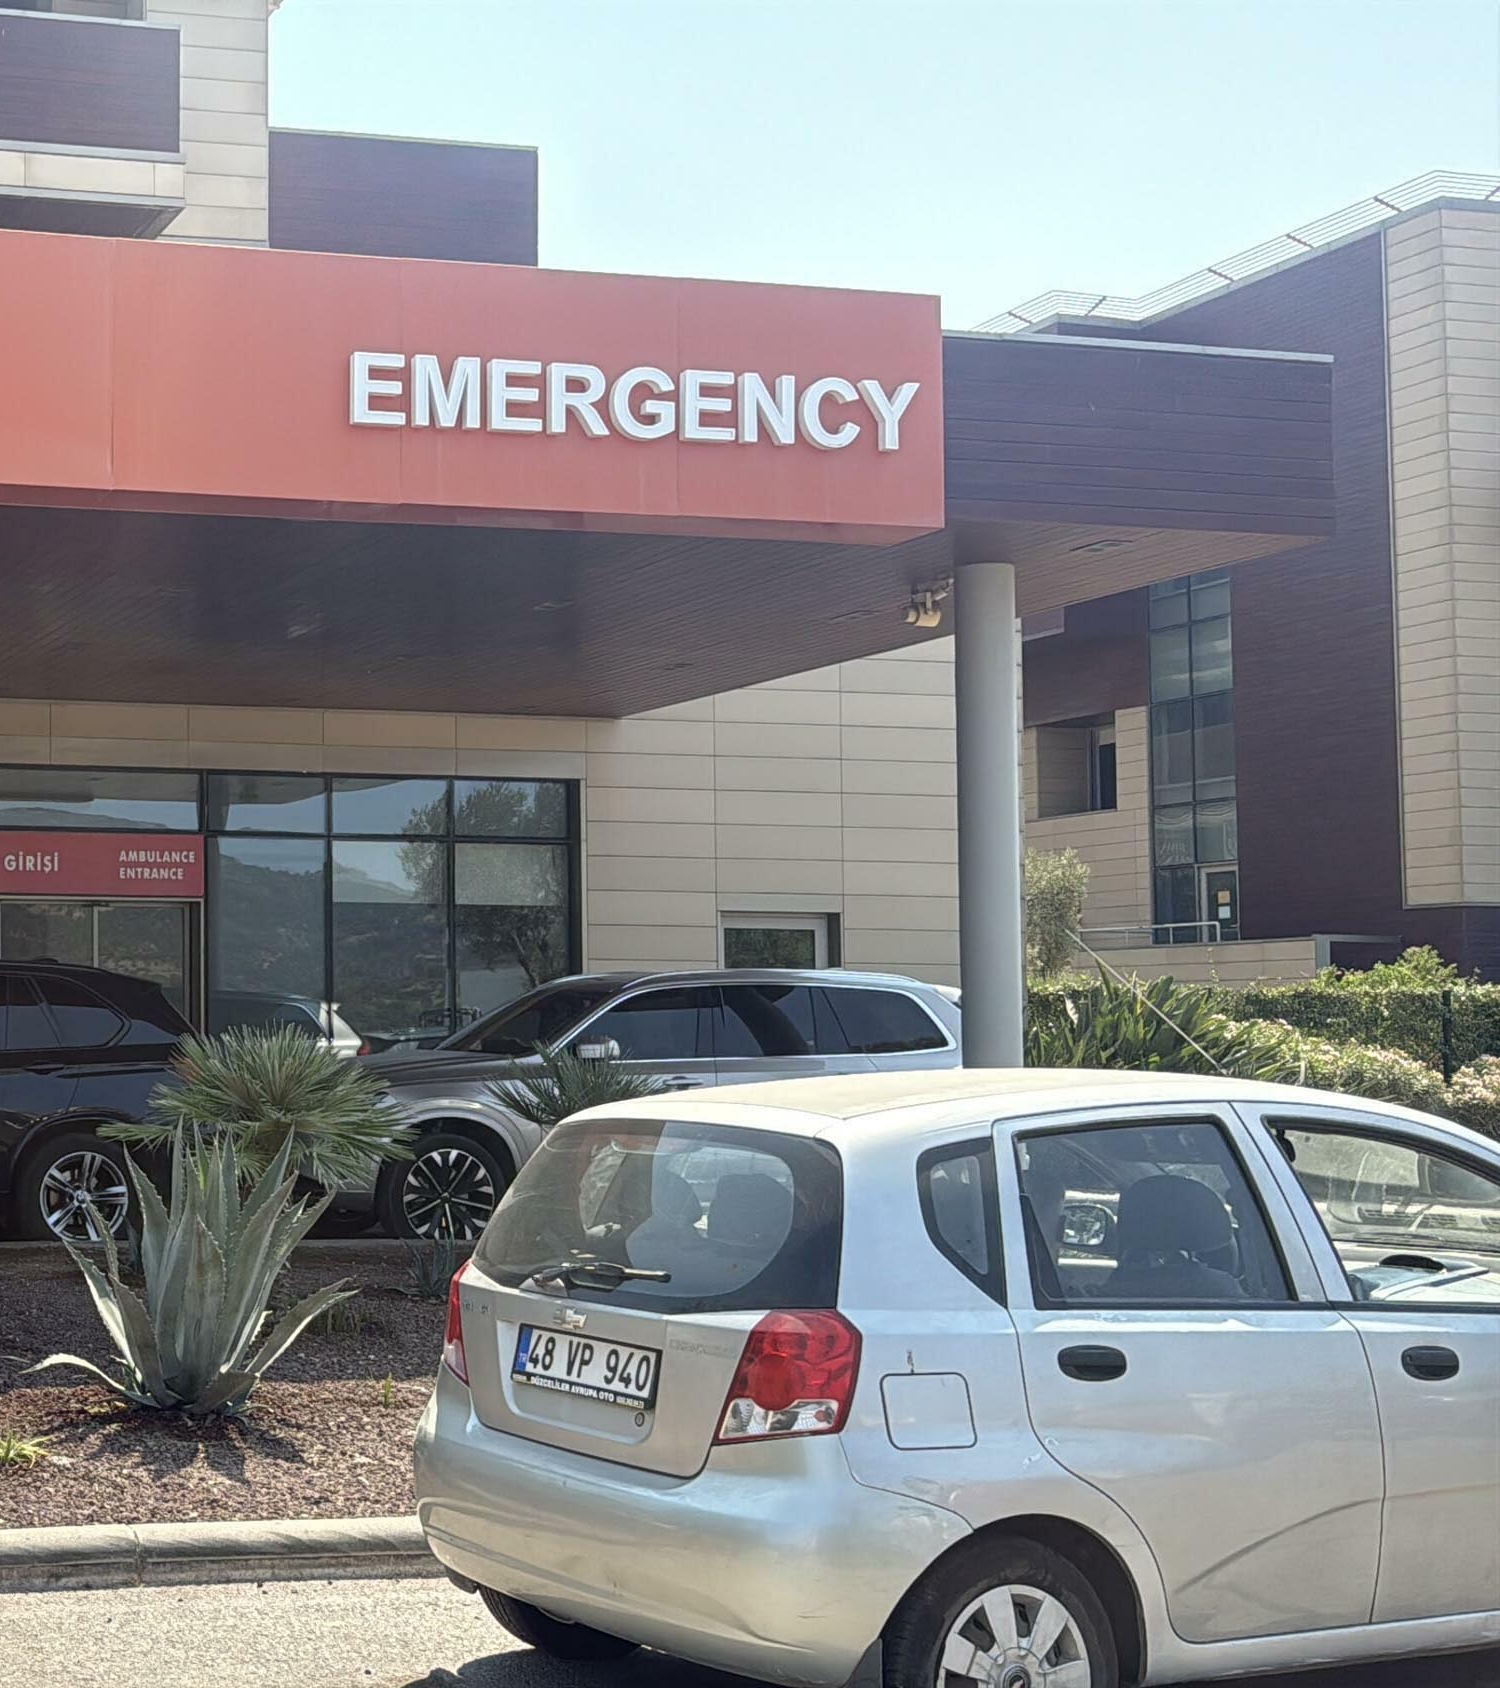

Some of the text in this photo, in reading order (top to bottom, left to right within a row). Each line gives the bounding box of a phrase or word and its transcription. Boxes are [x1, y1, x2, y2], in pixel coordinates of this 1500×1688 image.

[349, 351, 920, 453] EMERGENCY
[3, 851, 59, 875] GİRİŞİ
[119, 849, 196, 863] AMBULANCE
[119, 867, 184, 880] ENTRANCE
[528, 1333, 556, 1371] 48
[566, 1339, 594, 1378] VP
[603, 1349, 650, 1392] 940
[570, 1384, 598, 1398] AVRUPA
[598, 1391, 614, 1402] OTO
